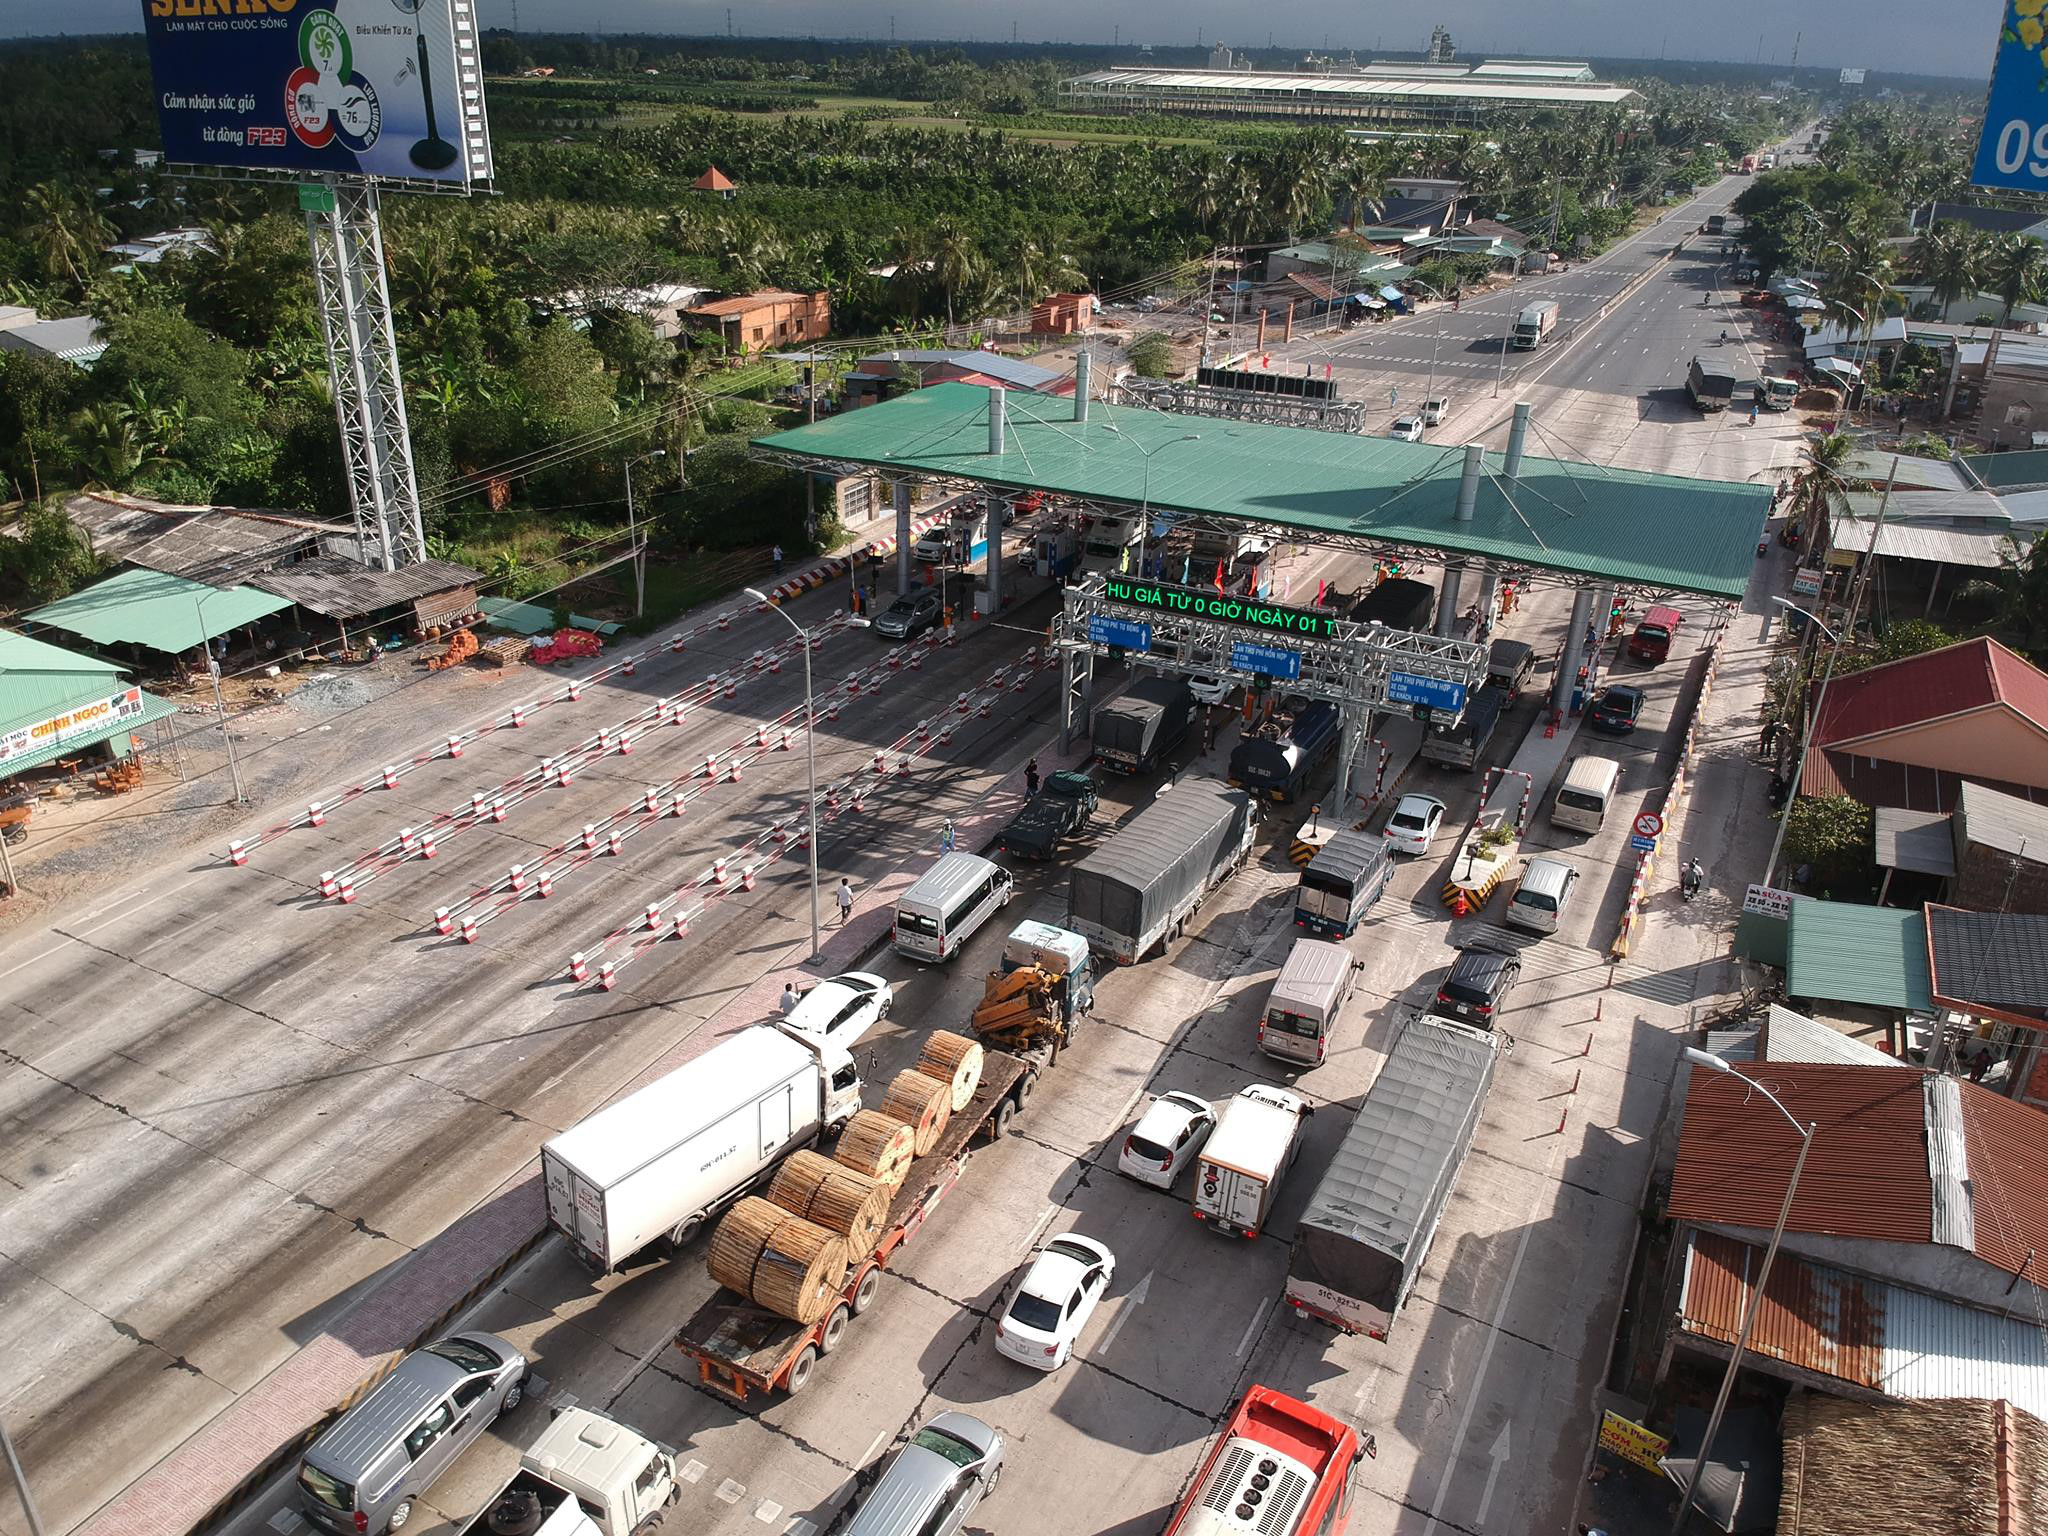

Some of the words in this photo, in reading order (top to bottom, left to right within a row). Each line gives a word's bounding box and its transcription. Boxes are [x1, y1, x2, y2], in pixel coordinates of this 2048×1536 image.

[207, 20, 228, 30] CHO
[247, 127, 287, 147] F23
[1135, 587, 1162, 606] GIÁ
[1166, 592, 1192, 609] TỪ
[1195, 599, 1206, 613] 0
[1208, 600, 1242, 619] GIỜ
[1245, 606, 1296, 628] NGÀY
[1298, 616, 1317, 633] 01
[31, 716, 71, 739] CHÍNH
[73, 702, 109, 723] NGỌC
